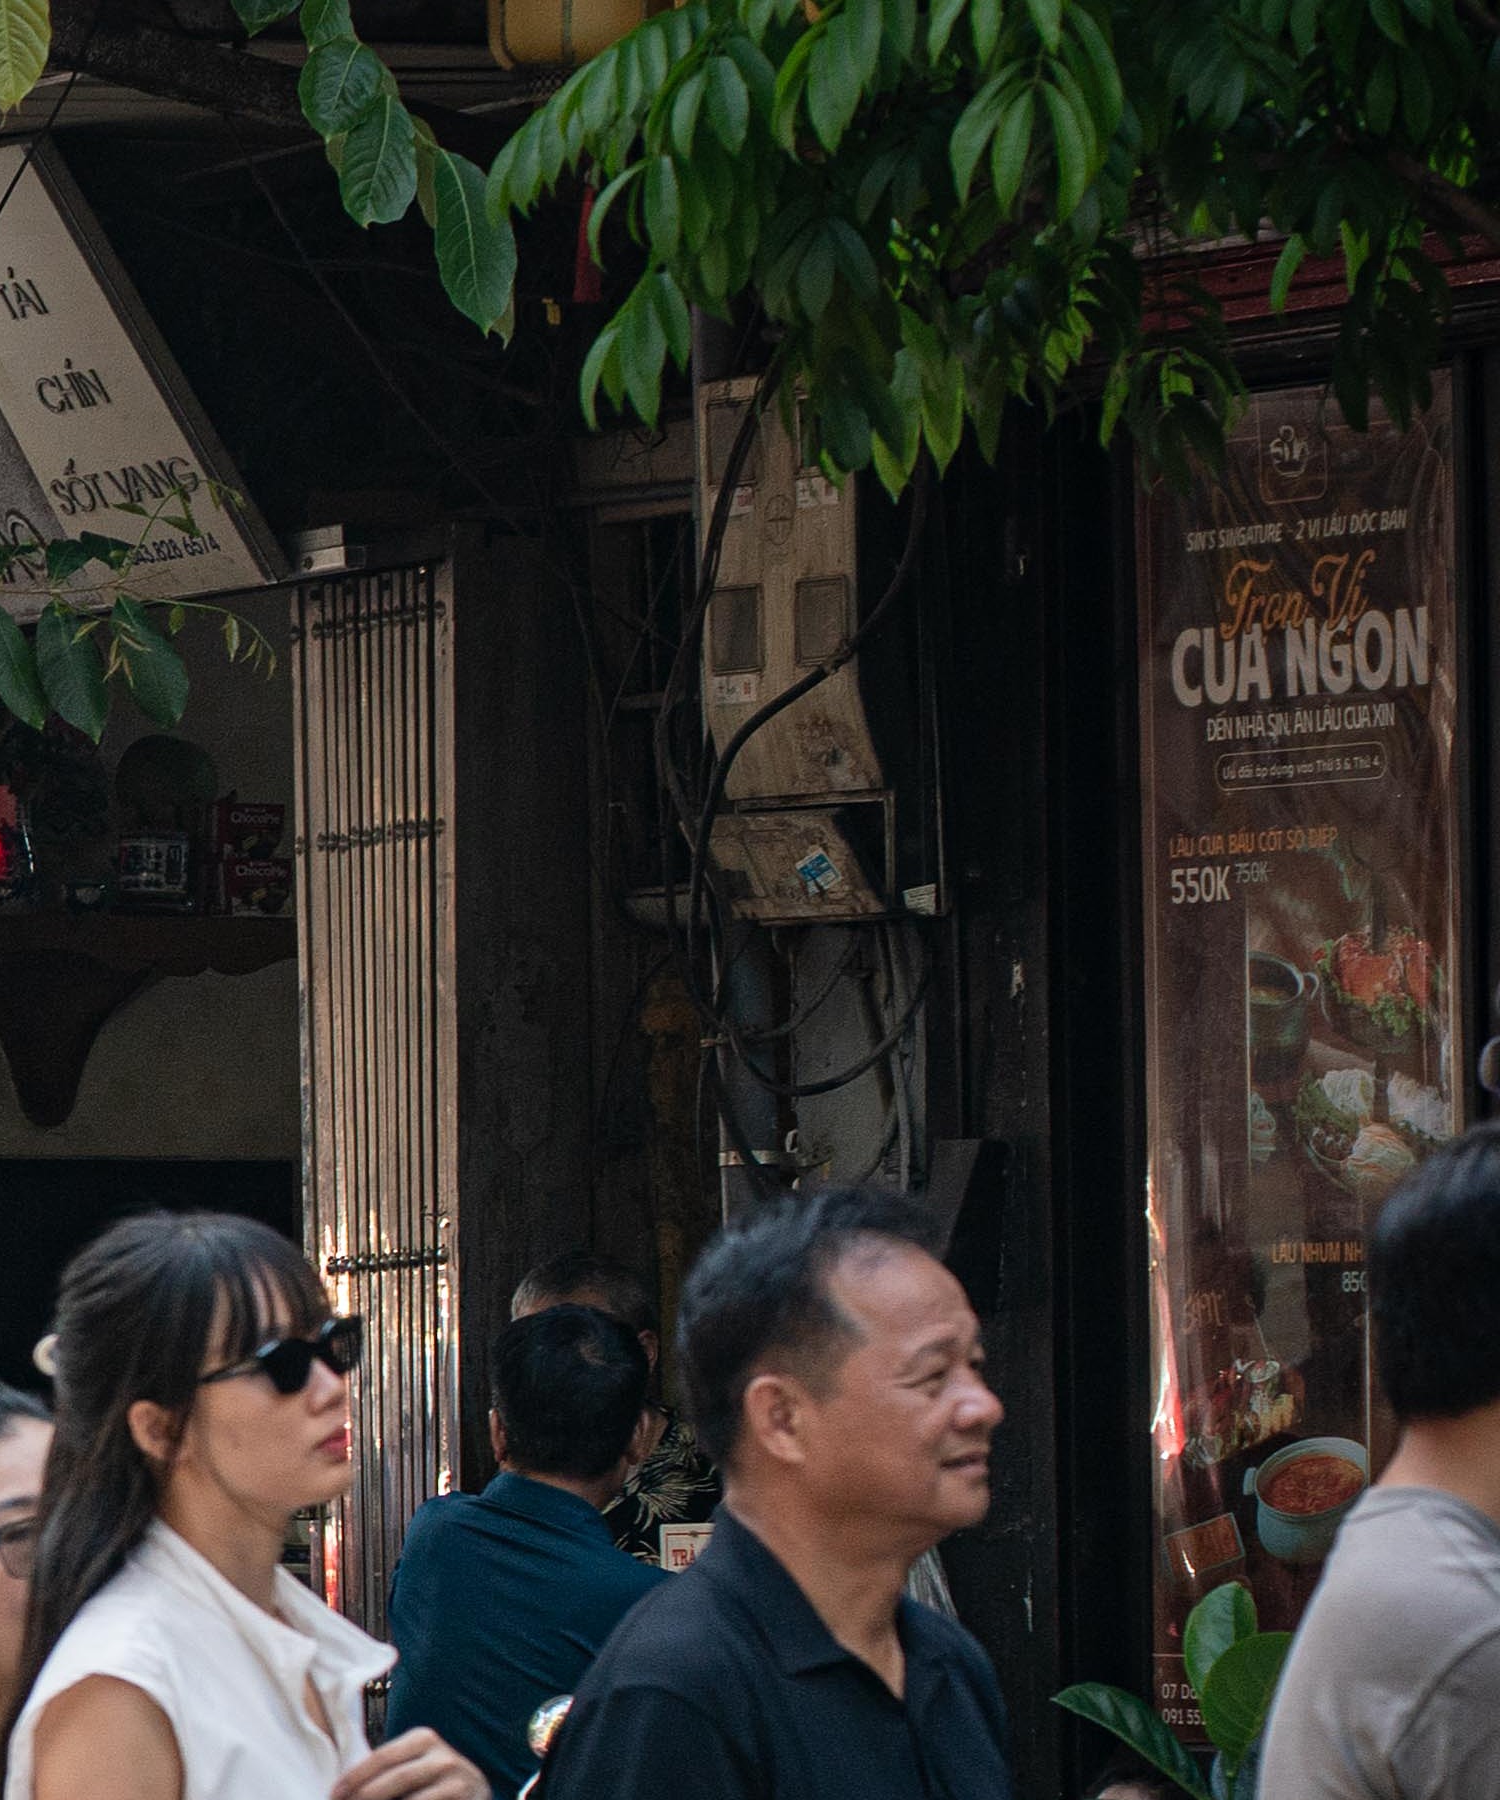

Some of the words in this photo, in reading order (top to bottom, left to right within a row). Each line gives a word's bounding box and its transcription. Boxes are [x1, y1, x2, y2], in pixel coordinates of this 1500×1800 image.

[35, 358, 111, 413] CHÍN
[50, 458, 111, 516] SỐT
[103, 456, 199, 503] VANG
[1285, 606, 1429, 696] NGON
[1207, 710, 1232, 741] ĐẾN
[1344, 704, 1371, 728] CUA
[1171, 866, 1231, 904] 550K
[1344, 1239, 1364, 1262] NH
[1162, 1683, 1177, 1699] 07
[1162, 1708, 1184, 1724] 091
[1186, 1708, 1207, 1726] 55
